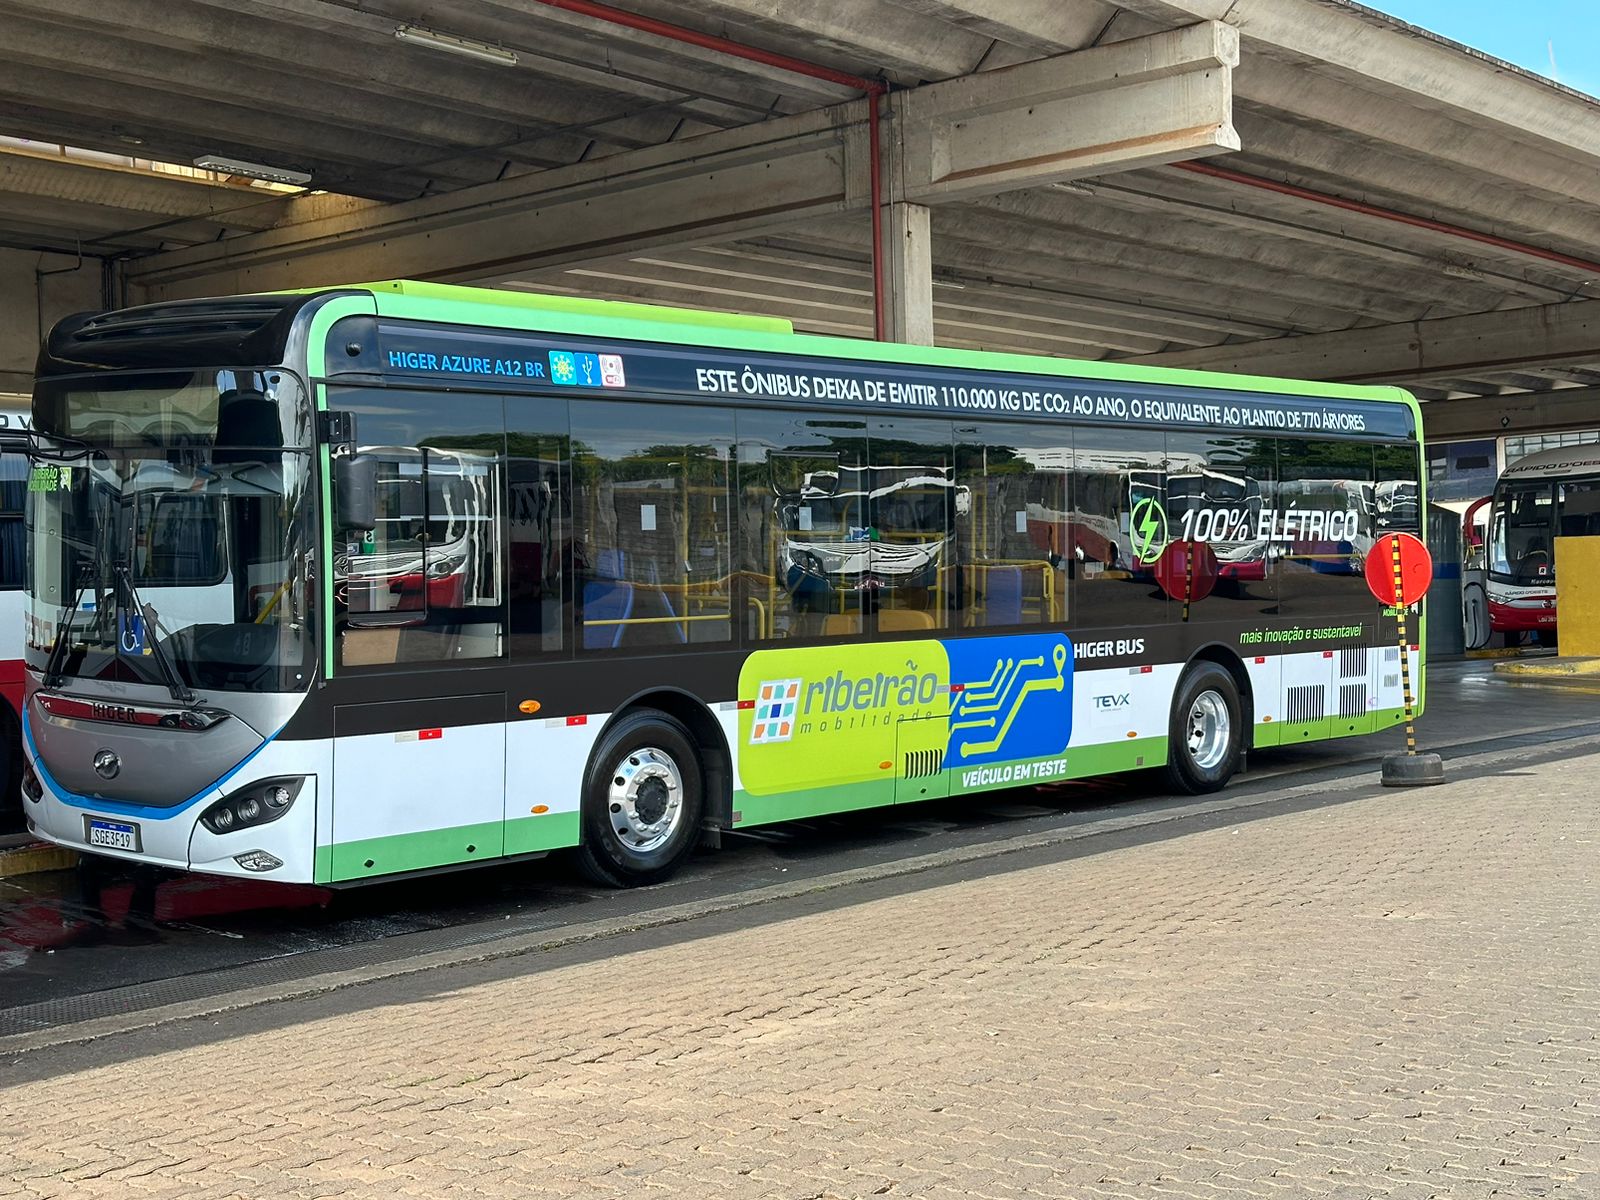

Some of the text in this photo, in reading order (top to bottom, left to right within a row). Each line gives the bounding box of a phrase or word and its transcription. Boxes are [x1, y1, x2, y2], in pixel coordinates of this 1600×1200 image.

[388, 351, 545, 378] HIGER AZURE A12 BR
[696, 368, 739, 393] ESTE
[741, 365, 811, 398] ÔNIBUS
[812, 377, 863, 401] DEIXA
[863, 380, 886, 403] DE
[888, 382, 939, 406] EMITIR
[941, 386, 997, 409] 110.000
[999, 390, 1020, 411] KG
[1022, 392, 1042, 412] DE
[1072, 395, 1093, 415] AO
[1095, 396, 1129, 421] ANO,
[1130, 399, 1142, 418] O
[1143, 400, 1222, 423] EQUIVALENTE
[1223, 406, 1240, 425] AO
[1241, 408, 1286, 428] PLANTIO
[1286, 410, 1302, 428] DE
[1301, 411, 1321, 429] 770
[1322, 407, 1366, 431] ÁRVORES
[1180, 500, 1359, 543] 100% ELÉTRICO
[1239, 628, 1262, 644] mais
[1264, 626, 1304, 645] inovação
[1305, 630, 1312, 639] e
[1073, 638, 1145, 659] HIGER BUS
[803, 659, 938, 715] ribeirão
[92, 702, 136, 722] HIGER
[1092, 693, 1130, 708] TEVX
[800, 709, 933, 734] mobilidade
[962, 759, 1067, 788] VEÍCULO EM TESTE
[95, 829, 131, 848] SGE3F19
